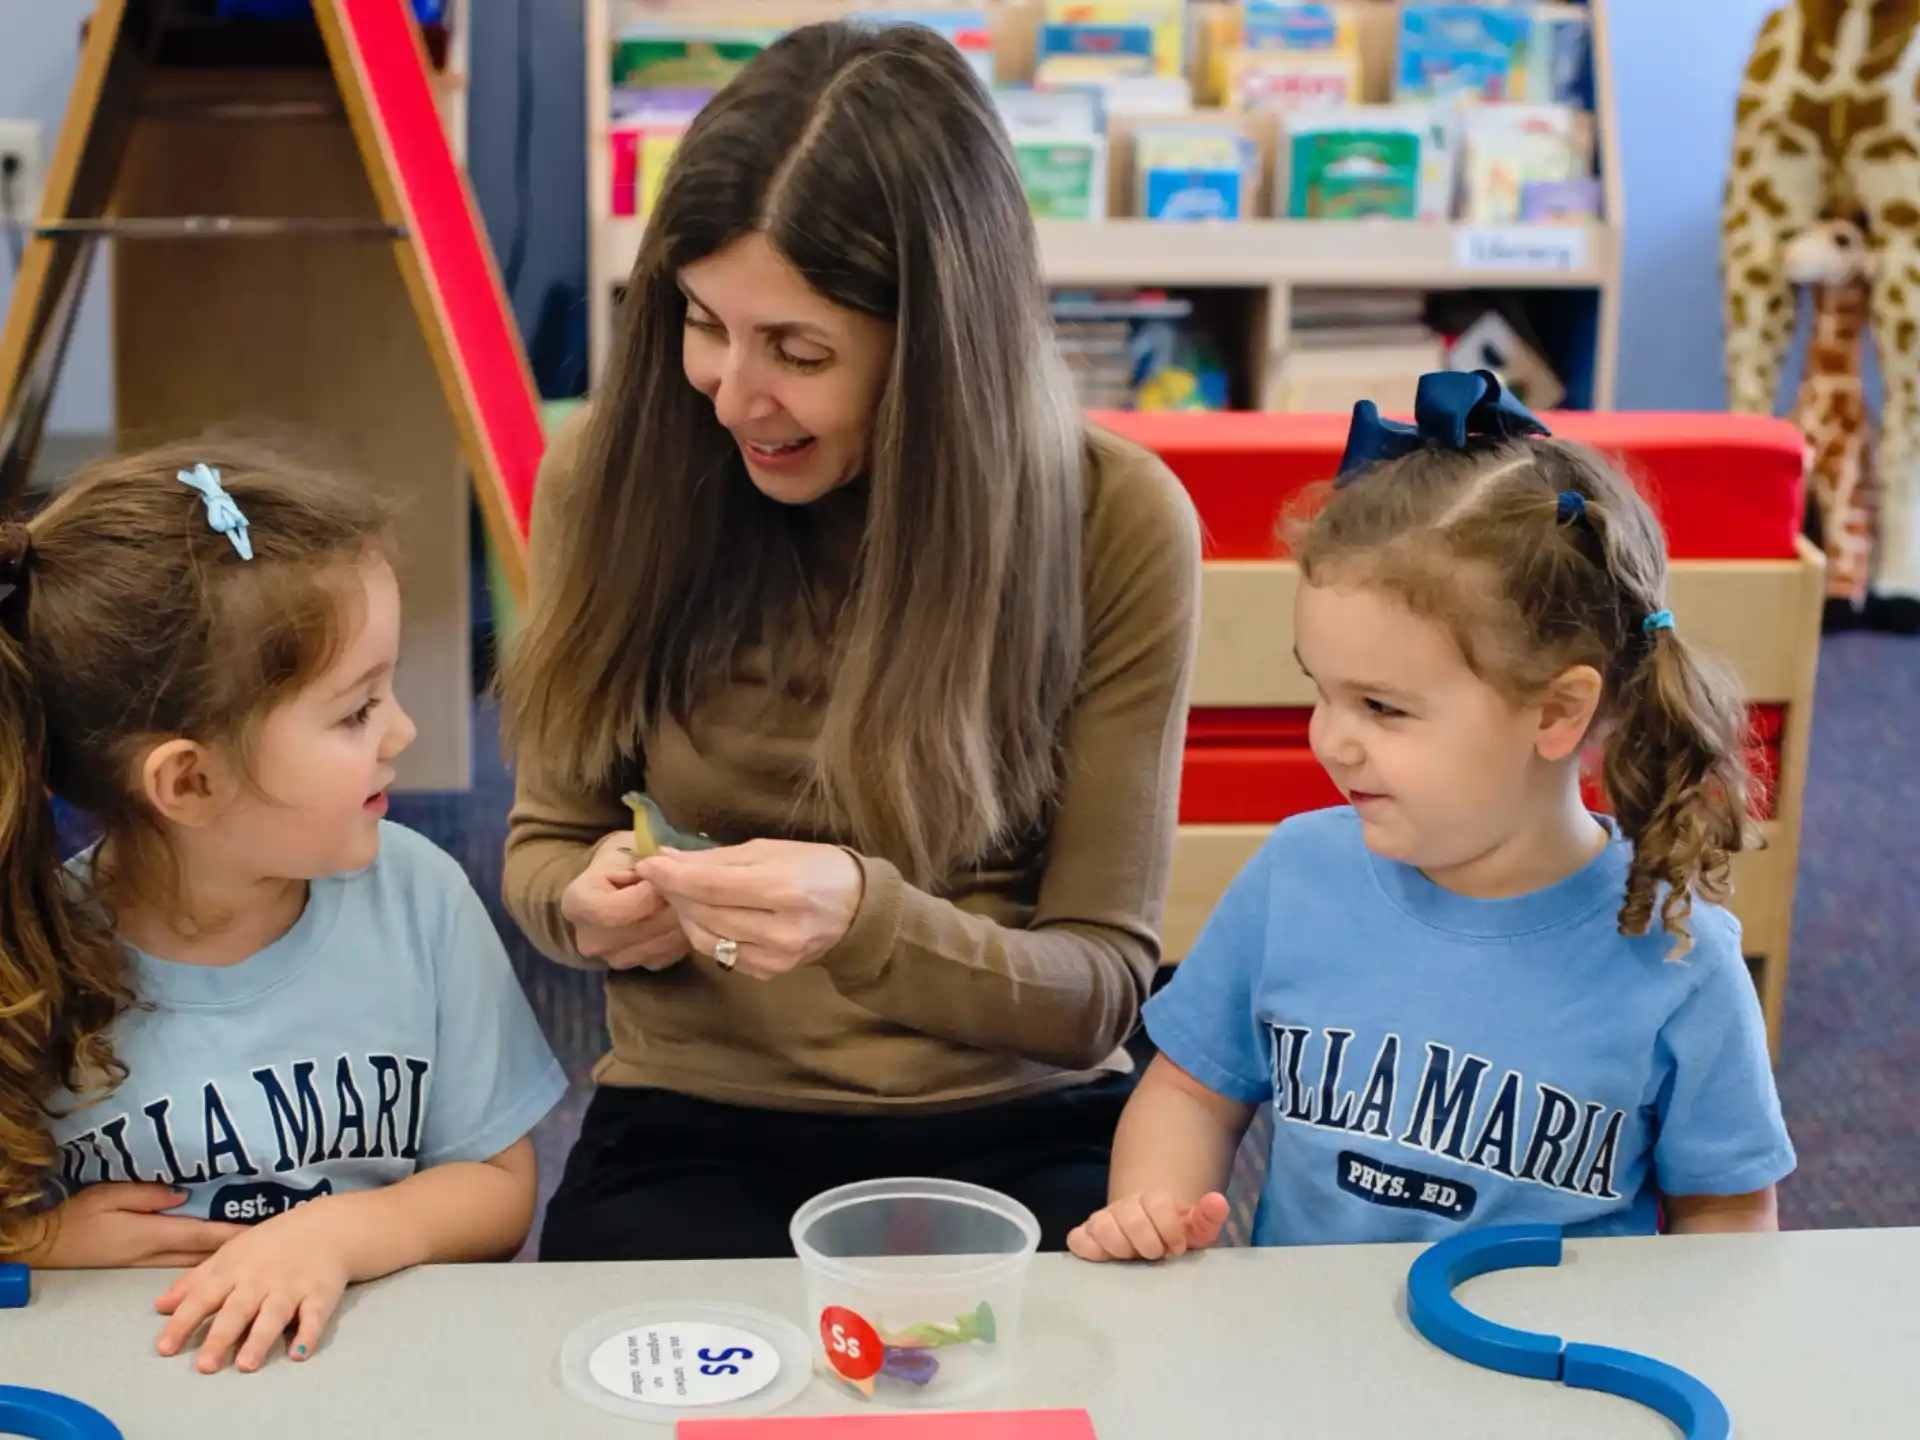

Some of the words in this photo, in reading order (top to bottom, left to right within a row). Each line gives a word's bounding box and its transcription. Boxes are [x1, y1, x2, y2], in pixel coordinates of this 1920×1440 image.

[251, 1053, 430, 1173] MARI
[1398, 1042, 1626, 1200] MARIA
[223, 1194, 275, 1219] est.
[1348, 1161, 1410, 1199] PHYS.
[1420, 1181, 1463, 1212] ED.
[698, 1348, 754, 1375] Ss
[831, 1323, 861, 1359] Ss
